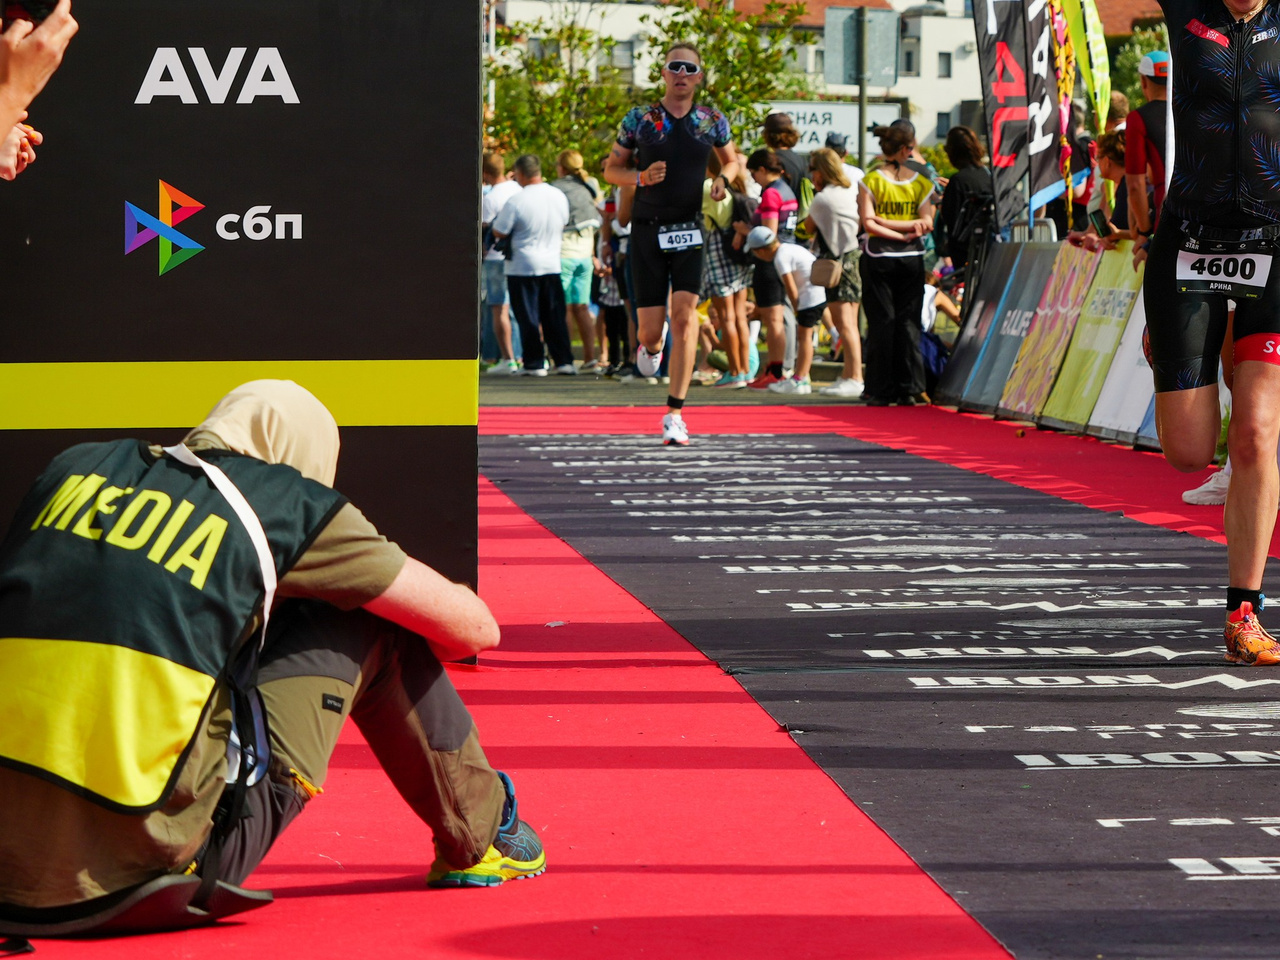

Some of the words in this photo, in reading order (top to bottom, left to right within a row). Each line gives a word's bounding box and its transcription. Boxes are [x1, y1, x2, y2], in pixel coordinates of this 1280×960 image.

[134, 47, 300, 104] AVA
[215, 205, 303, 240] сбп
[667, 233, 693, 245] 4057
[1190, 257, 1256, 280] 4600
[1209, 282, 1232, 291] АРИНА
[31, 472, 229, 590] MEDIA
[907, 674, 1160, 686] IRON
